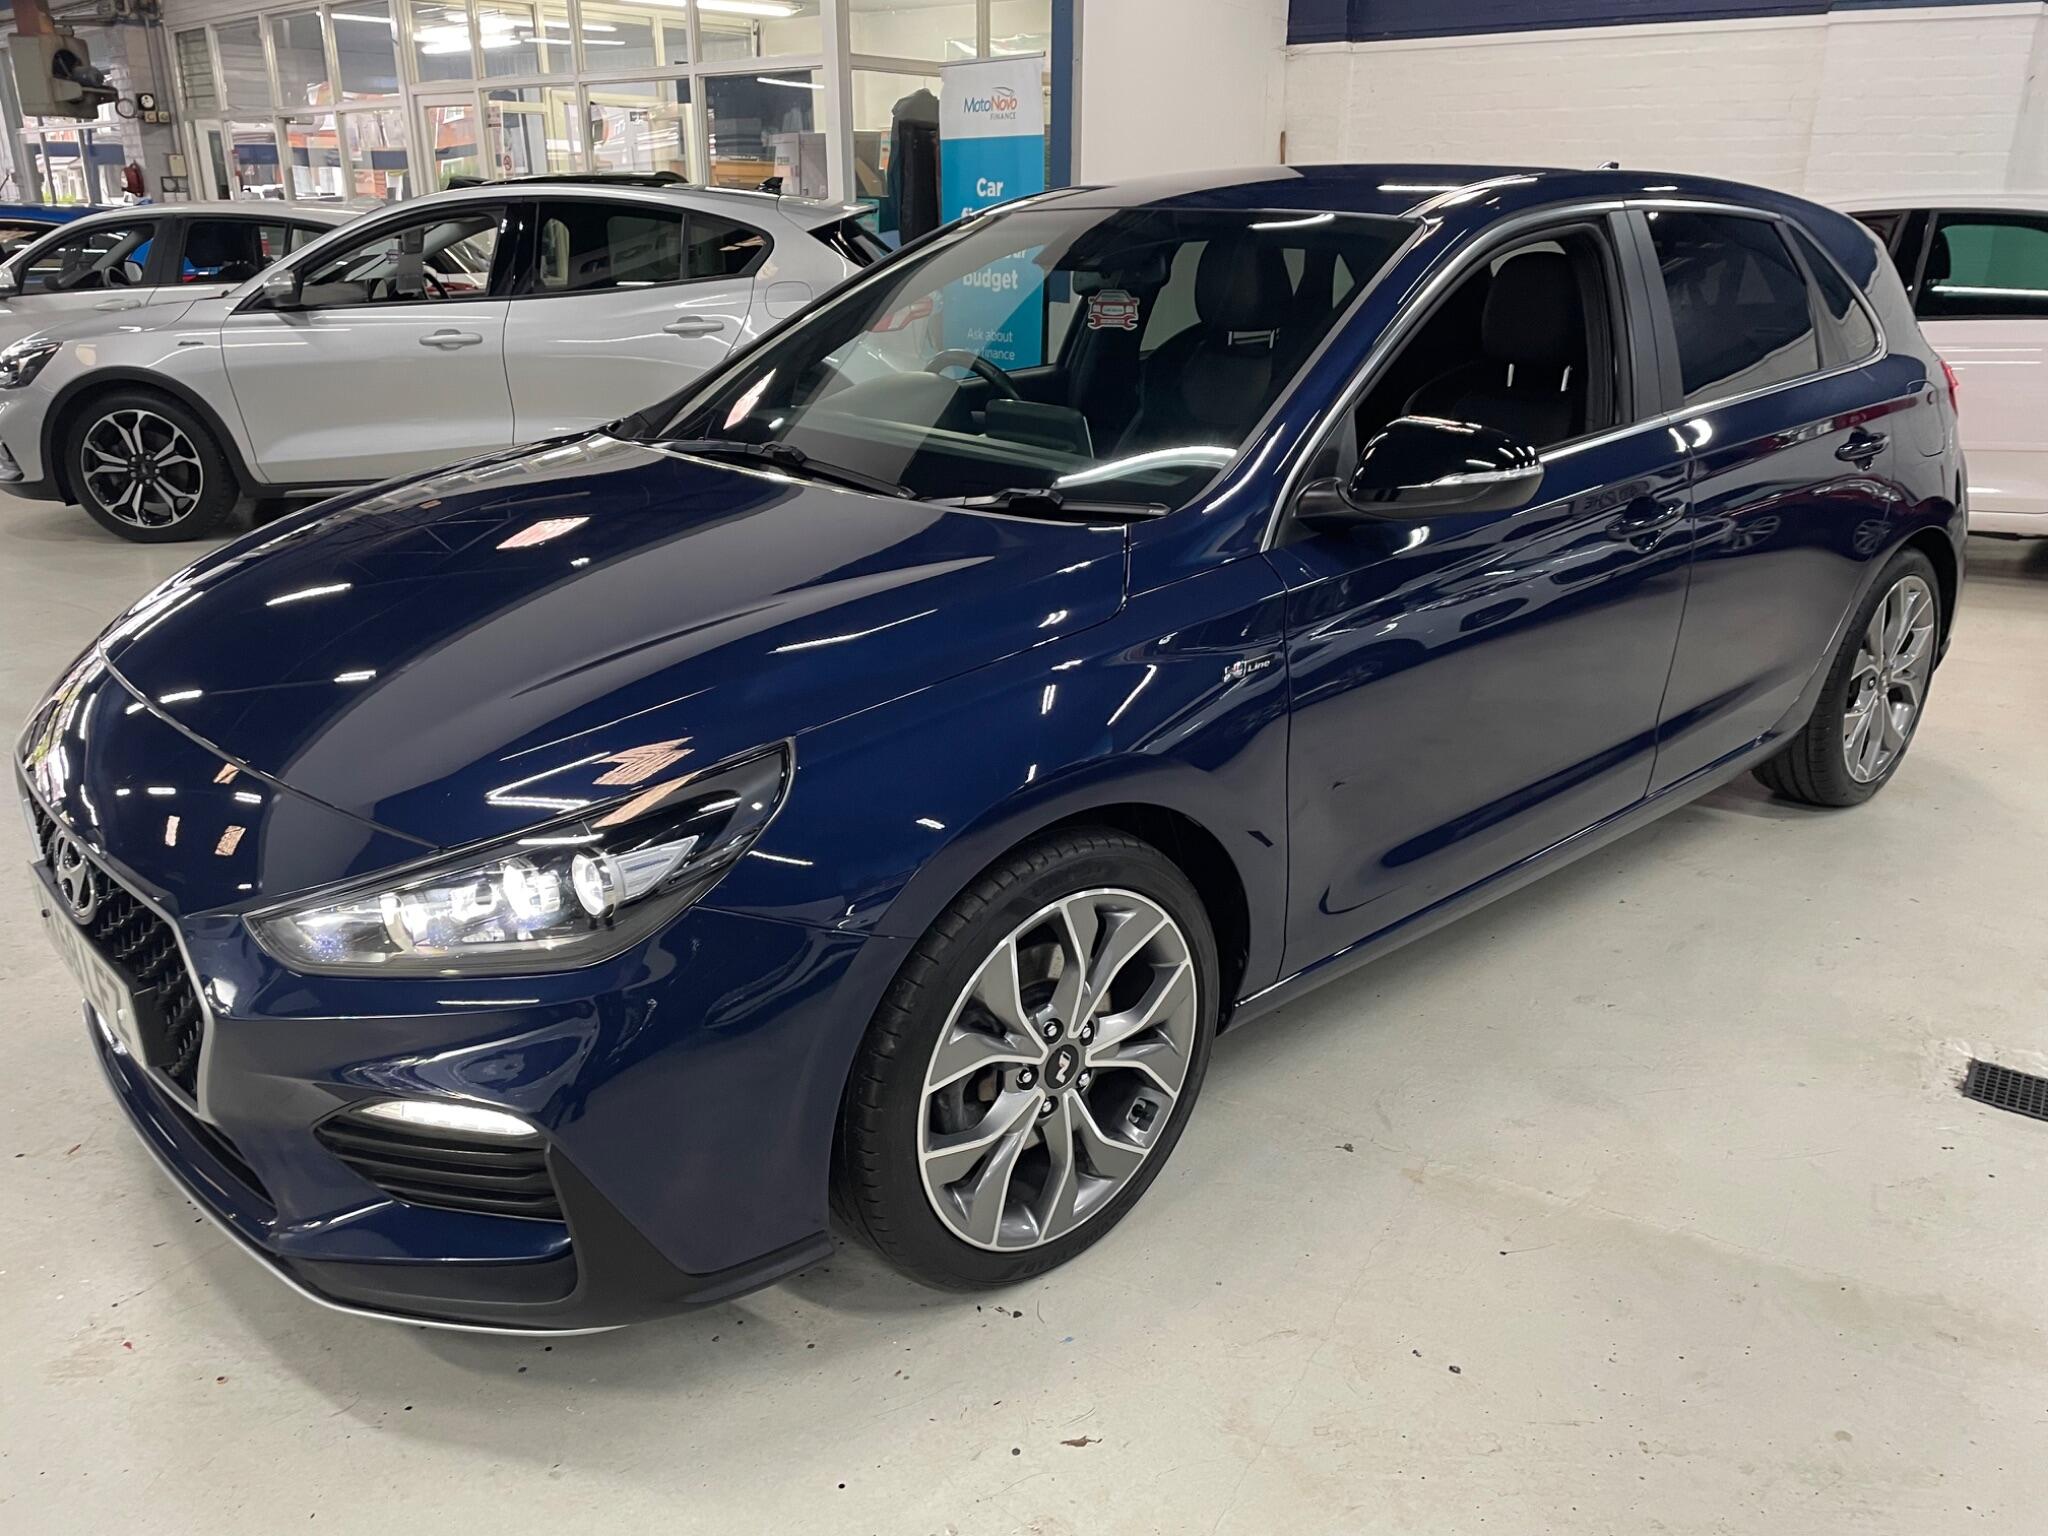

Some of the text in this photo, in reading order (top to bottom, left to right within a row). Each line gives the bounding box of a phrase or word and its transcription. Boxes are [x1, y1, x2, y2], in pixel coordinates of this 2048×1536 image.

[964, 95, 1018, 113] MotoNovo
[990, 112, 1017, 120] FINANCE
[976, 177, 1004, 197] Car
[967, 328, 1013, 343] Ask about
[1248, 660, 1270, 672] Line
